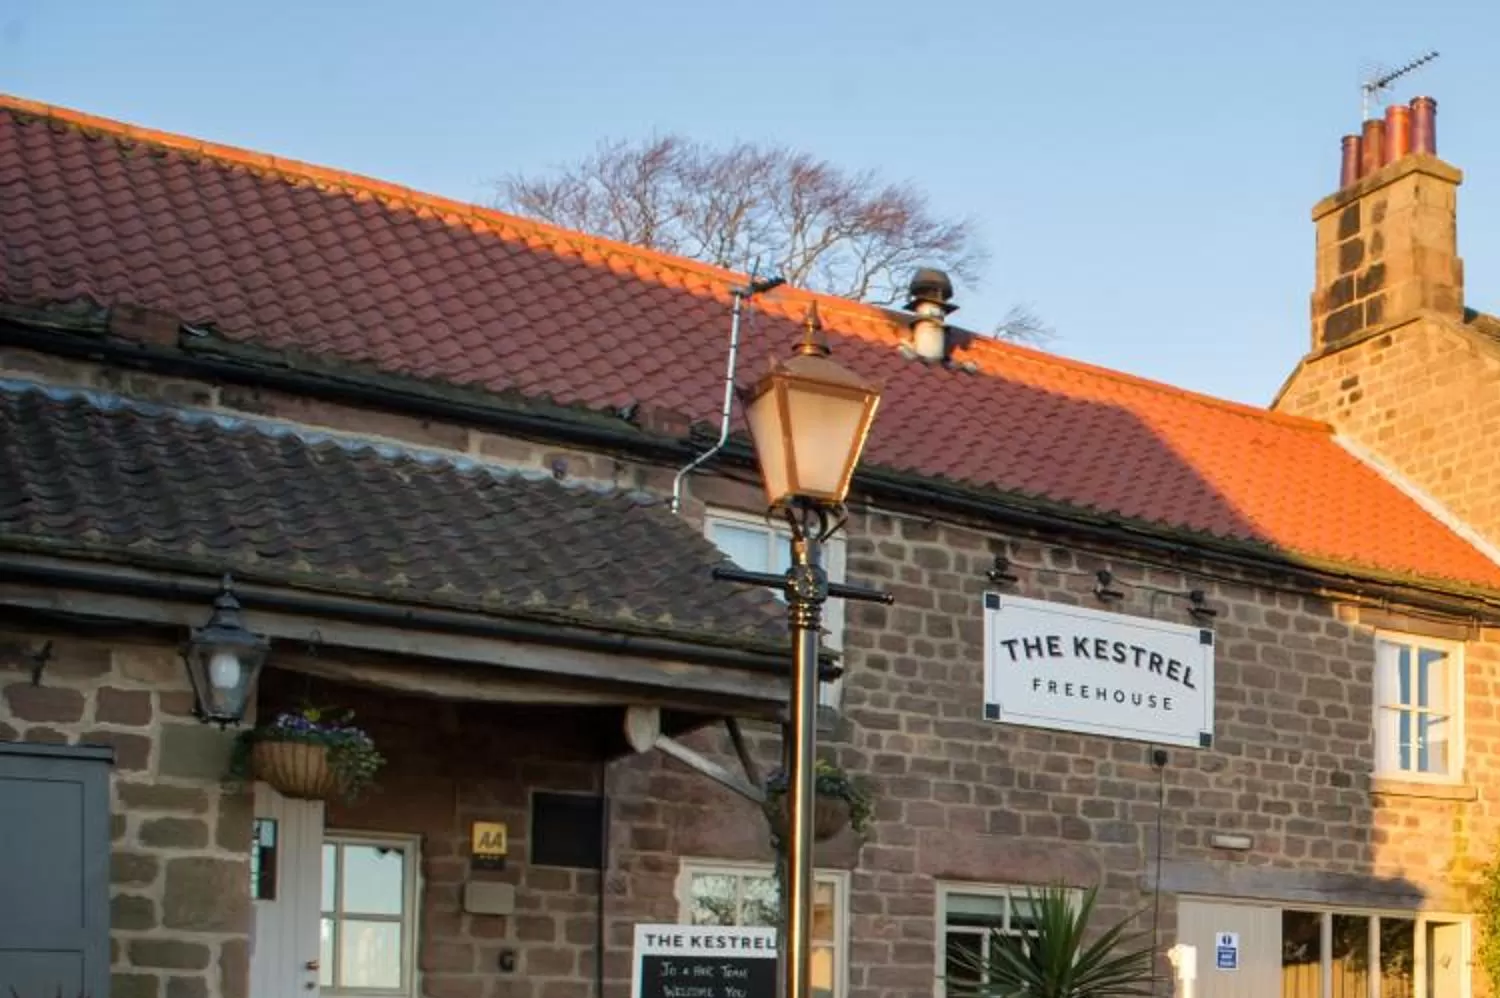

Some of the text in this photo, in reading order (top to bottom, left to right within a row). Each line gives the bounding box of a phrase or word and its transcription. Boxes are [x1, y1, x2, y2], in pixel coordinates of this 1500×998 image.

[1000, 635, 1196, 690] THE KESTREL
[1032, 677, 1173, 711] FREEHOUSE
[478, 831, 503, 849] AA
[644, 934, 777, 950] THE KESTREL
